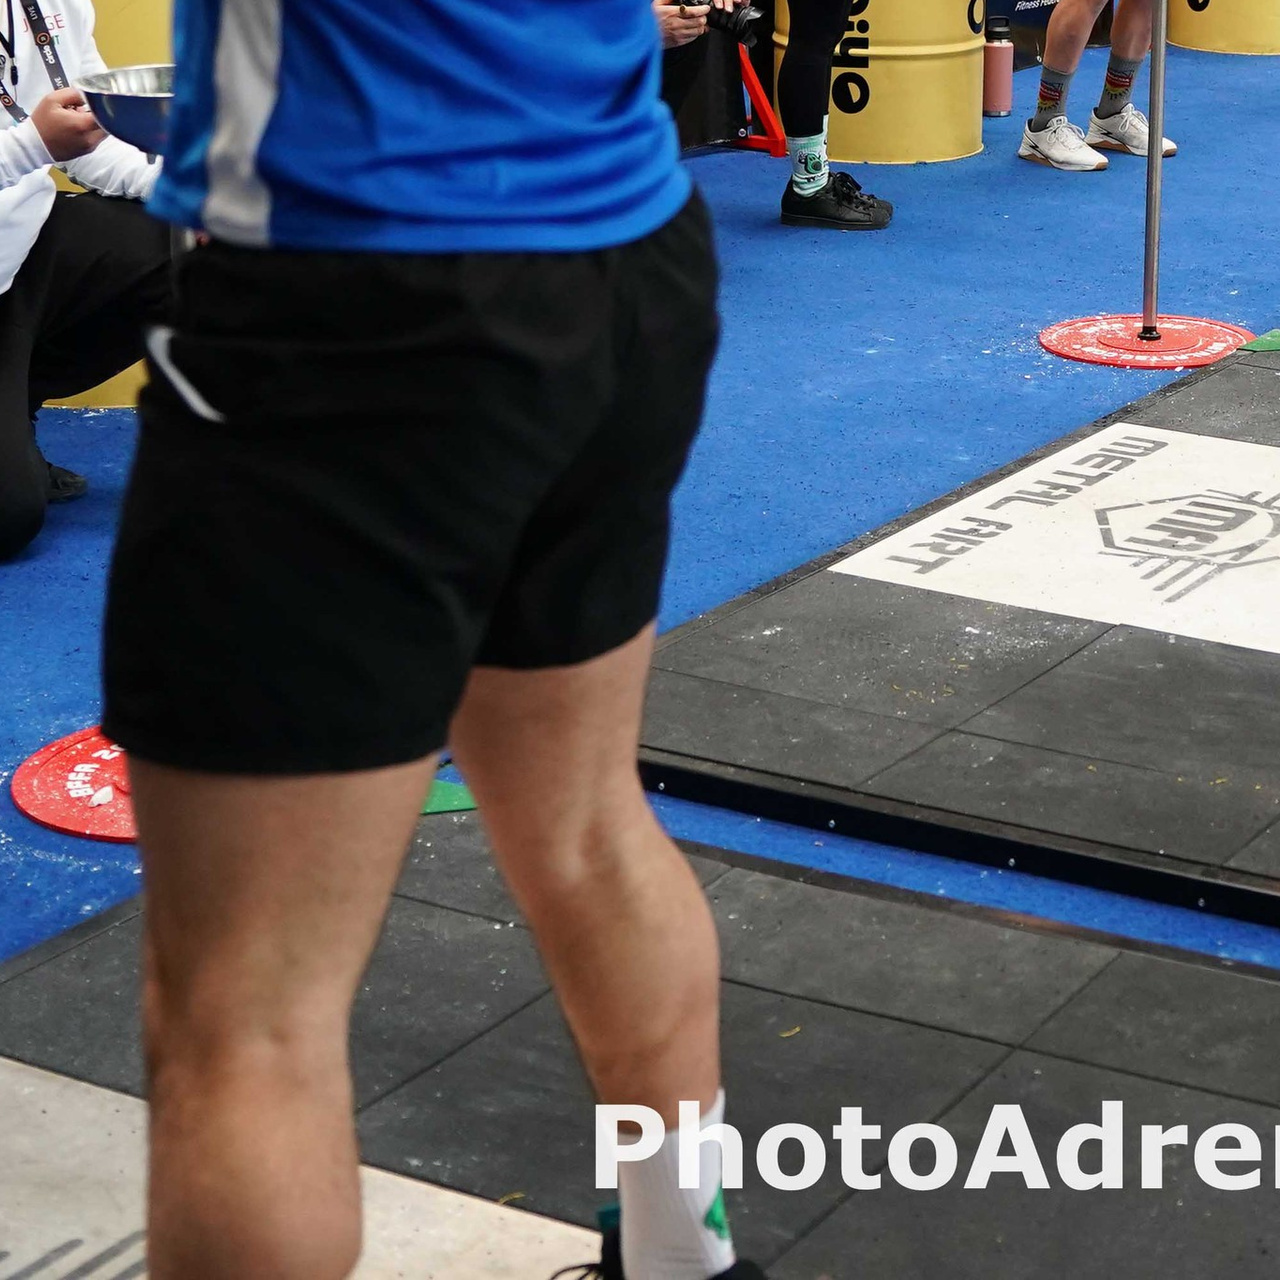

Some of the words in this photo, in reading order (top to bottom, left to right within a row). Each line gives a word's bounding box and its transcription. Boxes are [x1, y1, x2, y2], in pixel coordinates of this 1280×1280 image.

[28, 5, 39, 20] LIVE
[1014, 0, 1041, 11] Fitness
[23, 13, 65, 33] JGE
[43, 45, 55, 64] circle
[985, 435, 1169, 510] METAL
[886, 516, 1012, 575] ART
